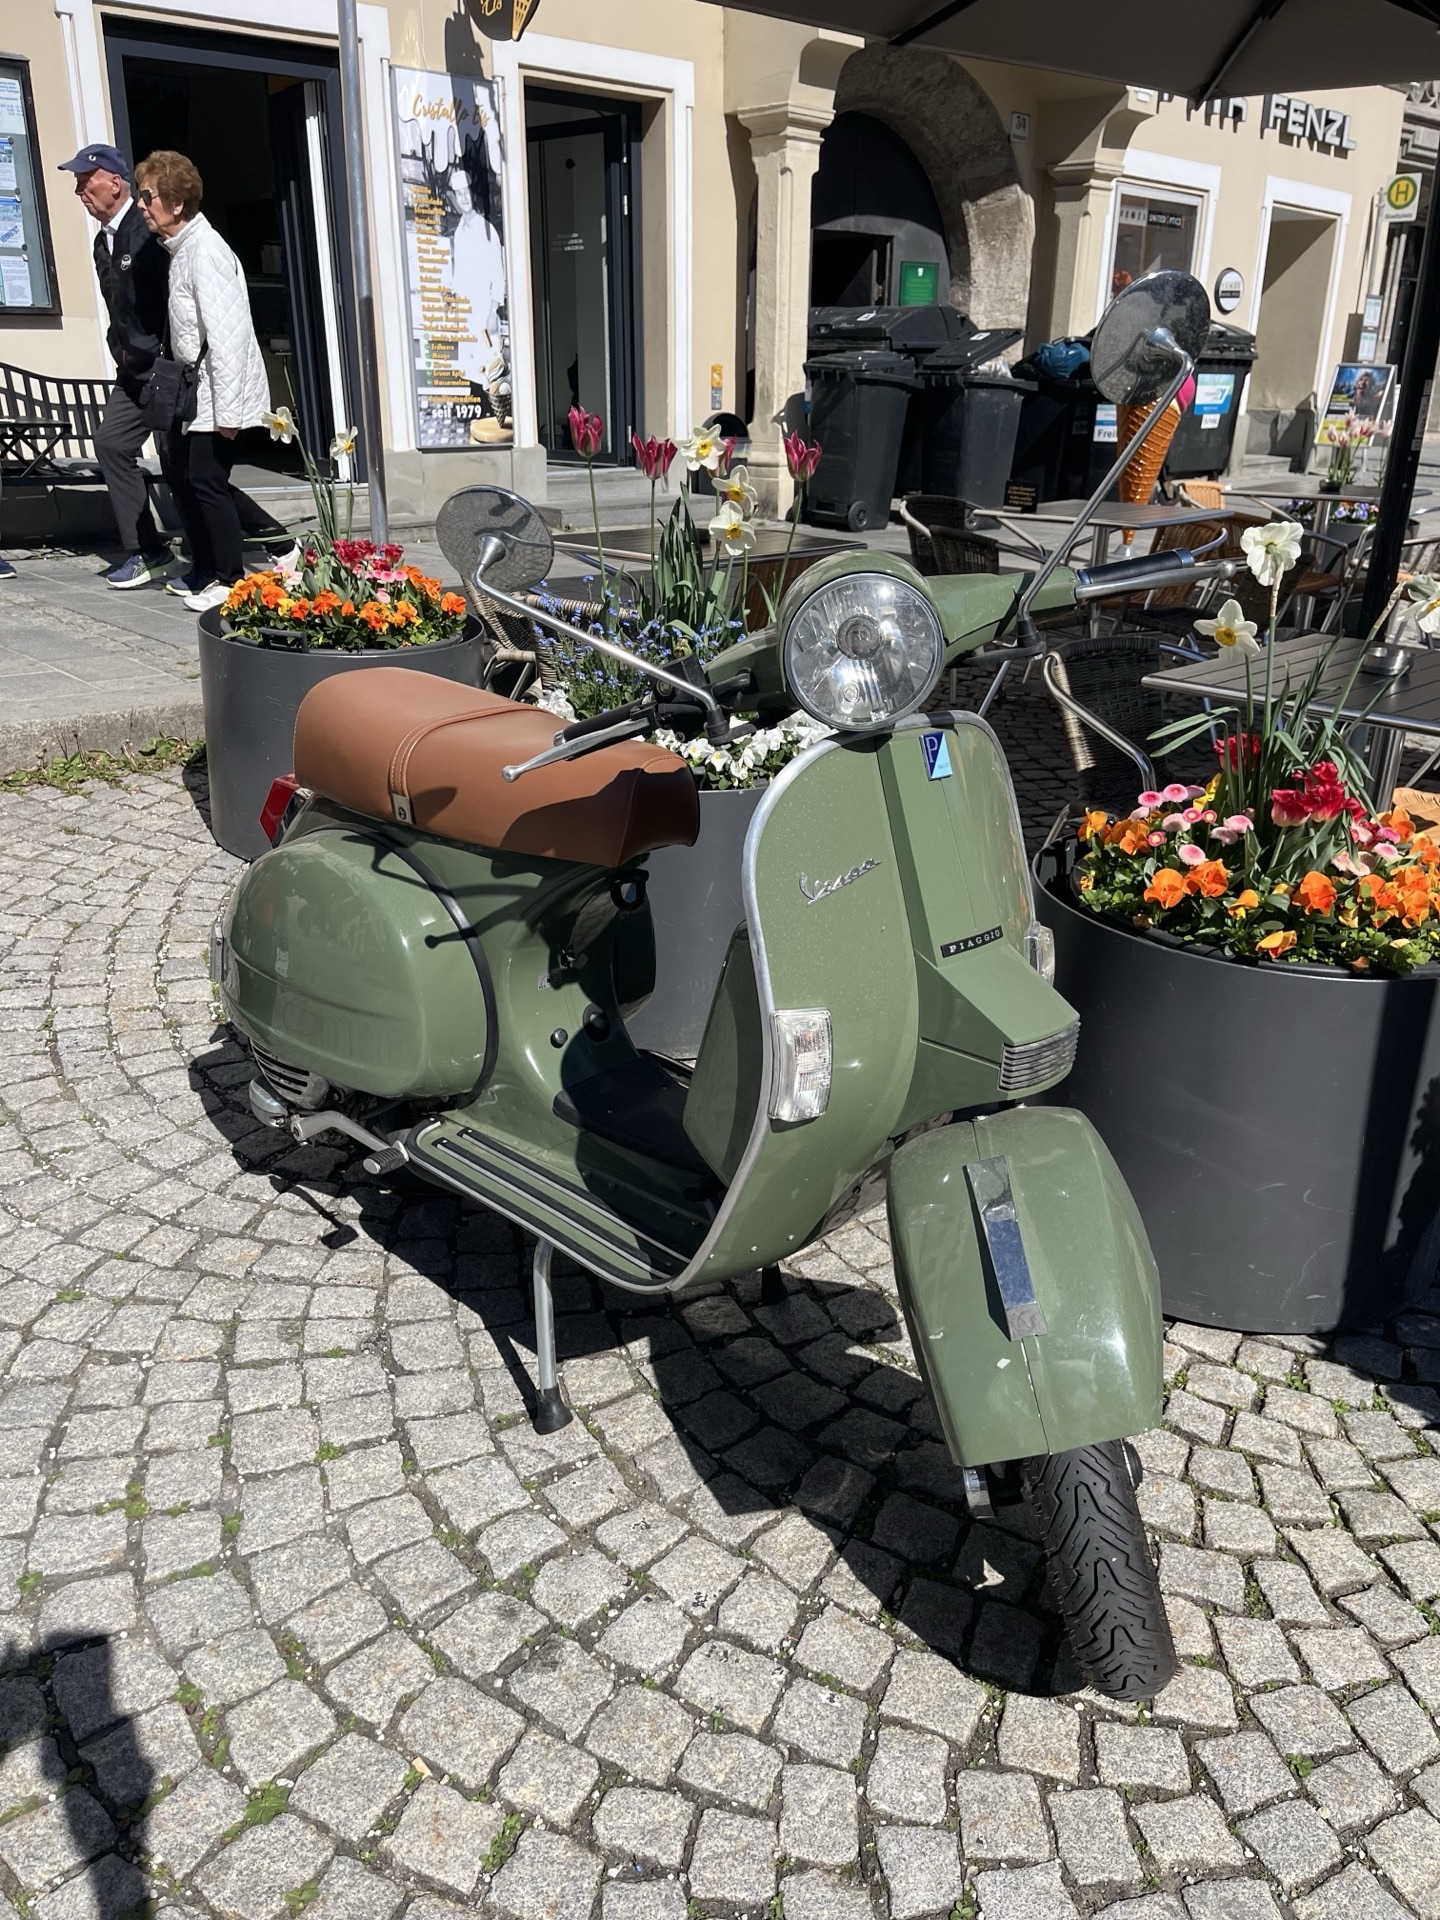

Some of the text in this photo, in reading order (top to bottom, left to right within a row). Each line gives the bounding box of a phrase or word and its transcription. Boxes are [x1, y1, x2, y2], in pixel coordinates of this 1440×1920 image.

[412, 93, 469, 126] Cristallo
[1265, 93, 1357, 150] FENZL
[1395, 182, 1410, 203] H
[431, 404, 482, 419] seit 1979
[924, 736, 939, 764] P
[799, 857, 883, 907] Vespa
[949, 929, 1001, 953] PIAGGIO
